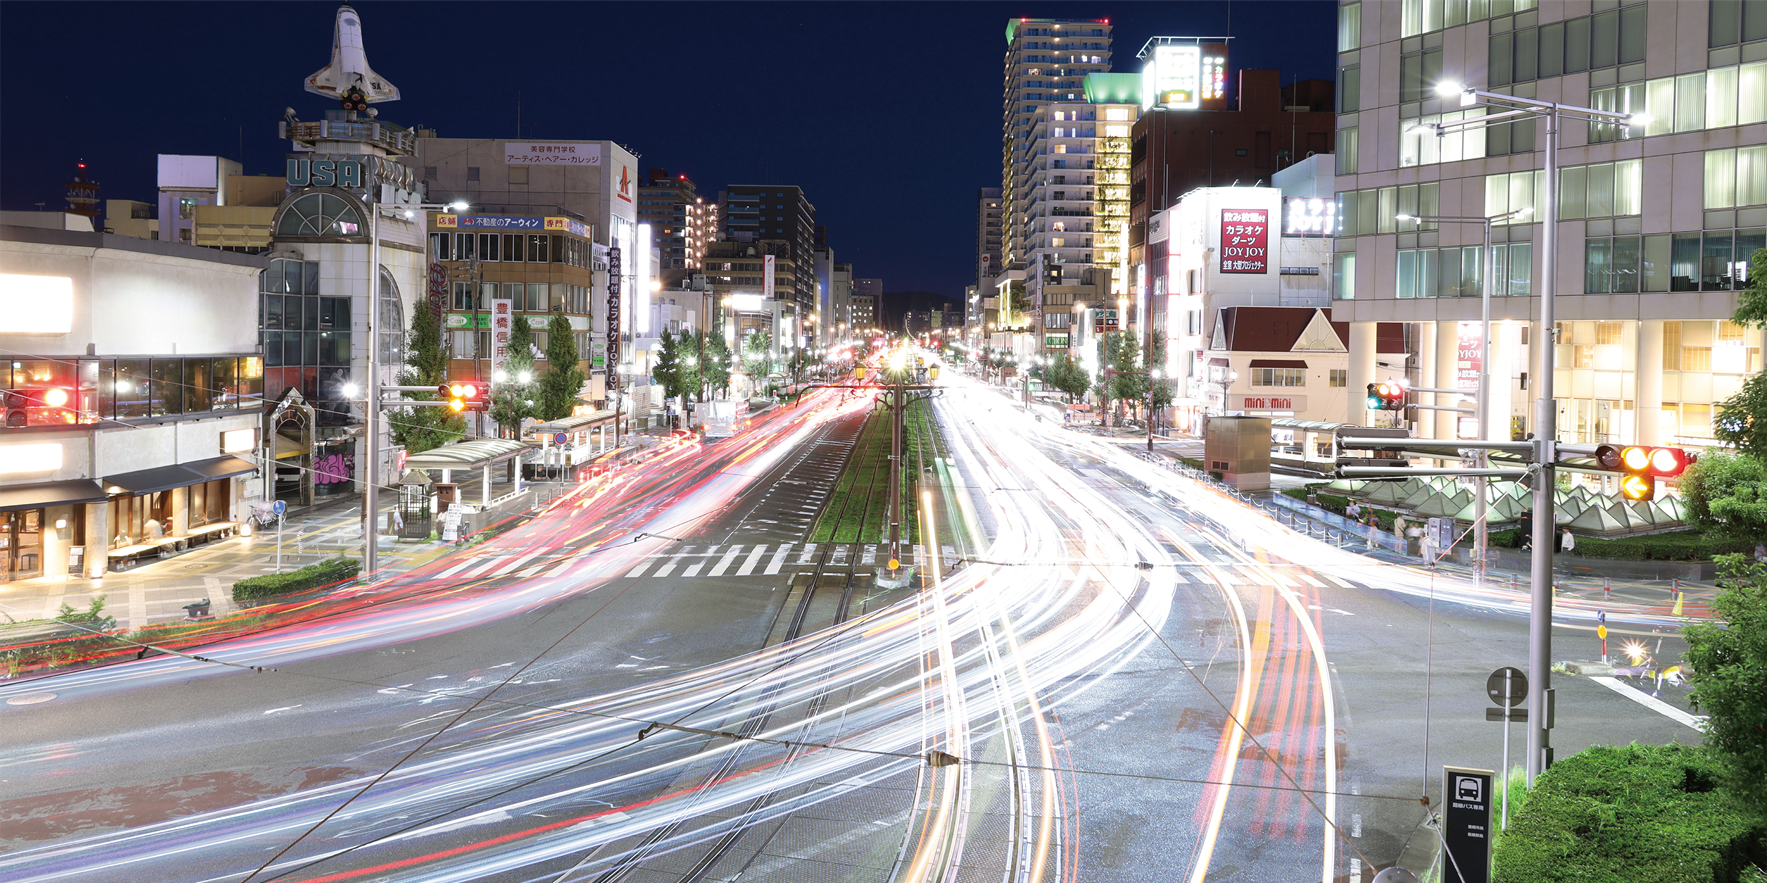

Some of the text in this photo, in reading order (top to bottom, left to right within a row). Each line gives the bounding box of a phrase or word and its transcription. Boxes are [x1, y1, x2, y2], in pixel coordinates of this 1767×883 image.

[530, 145, 576, 153] 美容専門学校
[286, 159, 361, 187] USA
[475, 217, 539, 227] 不動産のアーウィン
[546, 219, 563, 228] 専門
[1226, 225, 1264, 235] カラオケ
[1231, 236, 1256, 246] ダーツ
[610, 297, 619, 341] カラオケ
